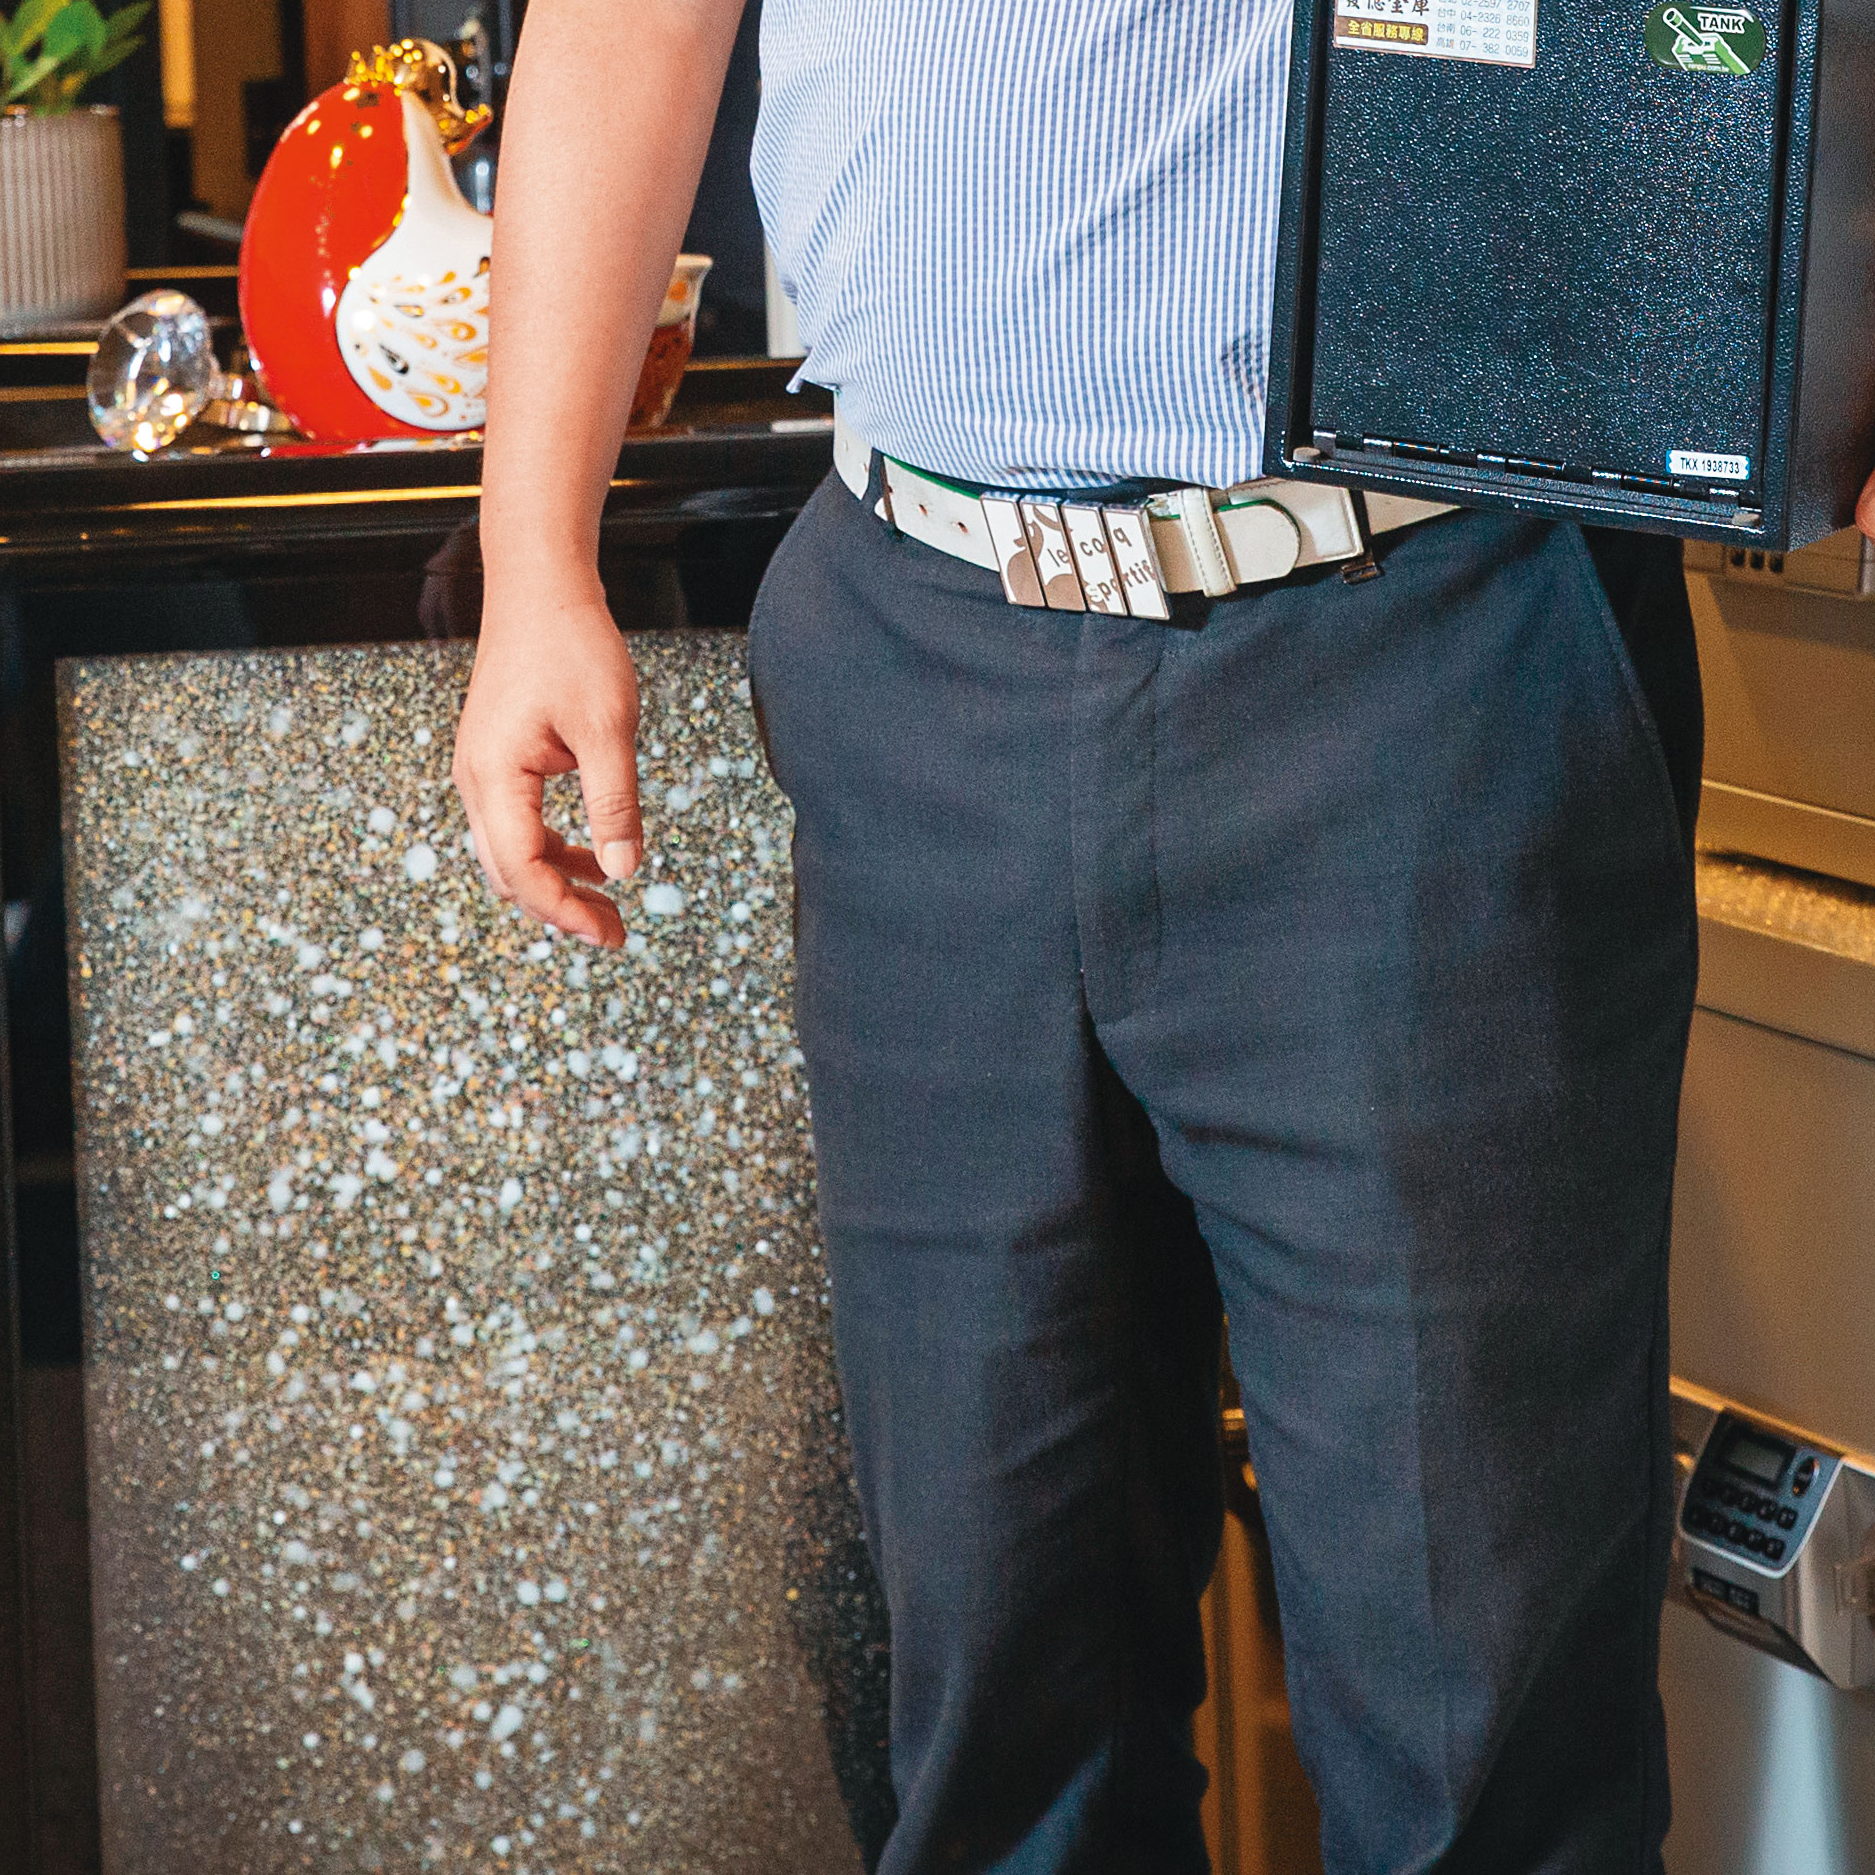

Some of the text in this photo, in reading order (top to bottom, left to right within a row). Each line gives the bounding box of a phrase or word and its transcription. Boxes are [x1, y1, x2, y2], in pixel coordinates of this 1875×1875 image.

[1506, 0, 1530, 12] 2707
[1461, 11, 1501, 24] 04-2326
[1506, 16, 1530, 27] 8660
[1699, 14, 1744, 32] TANK
[1348, 20, 1425, 42] 全省服務專線
[1483, 28, 1501, 39] 222
[1505, 30, 1529, 42] 0359
[1505, 45, 1528, 57] 0059
[1680, 457, 1739, 474] TKX 1938733
[1047, 527, 1132, 568] le coq
